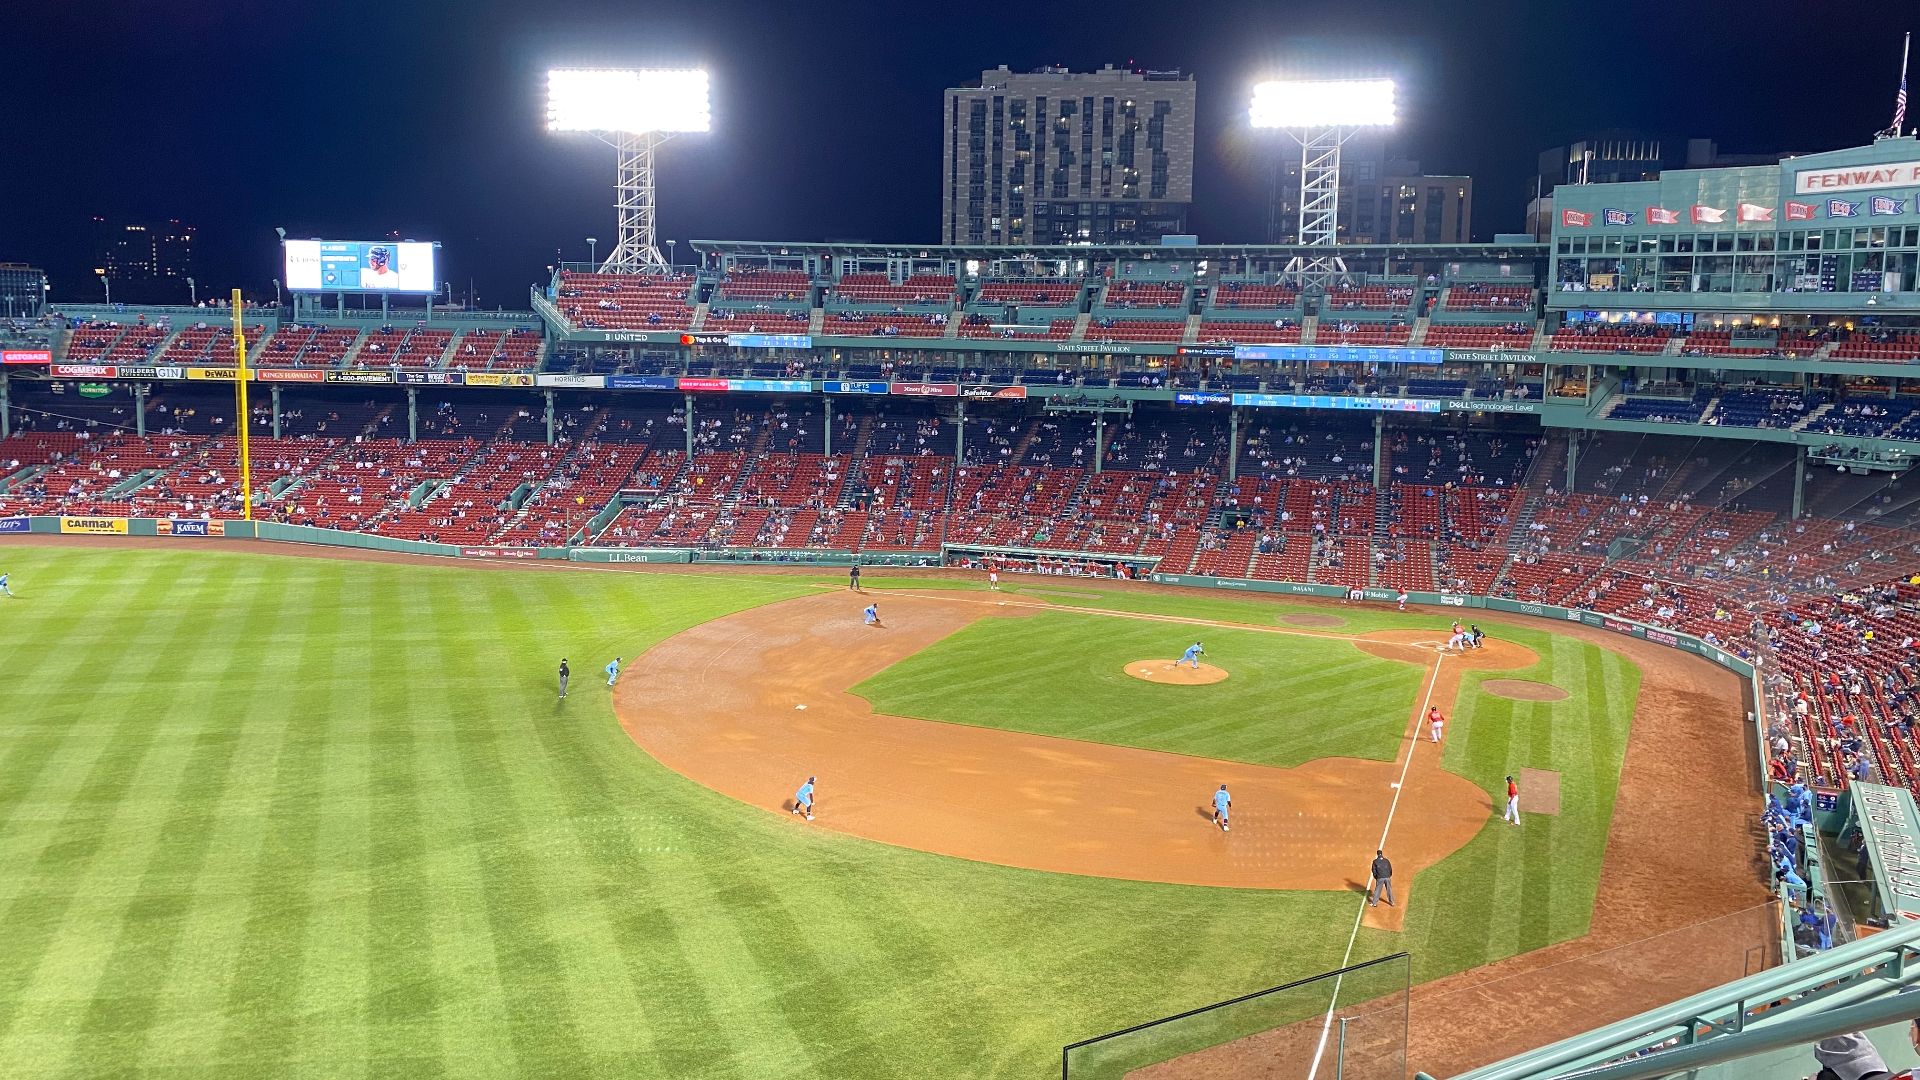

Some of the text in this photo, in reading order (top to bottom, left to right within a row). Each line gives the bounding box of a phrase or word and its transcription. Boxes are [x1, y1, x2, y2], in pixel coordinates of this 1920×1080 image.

[1807, 169, 1898, 188] FENWAY
[1076, 344, 1099, 352] STREET
[1100, 344, 1131, 352] PAVILION
[5, 353, 48, 361] GATORADE
[1449, 352, 1536, 362] STATE STREET PAVILION
[57, 366, 107, 375] COGMEDIX
[158, 368, 179, 377] GIN
[1470, 403, 1513, 411] Technologies
[1515, 404, 1534, 412] Level
[176, 523, 204, 535] KAYEM
[1860, 787, 1908, 829] PARK
